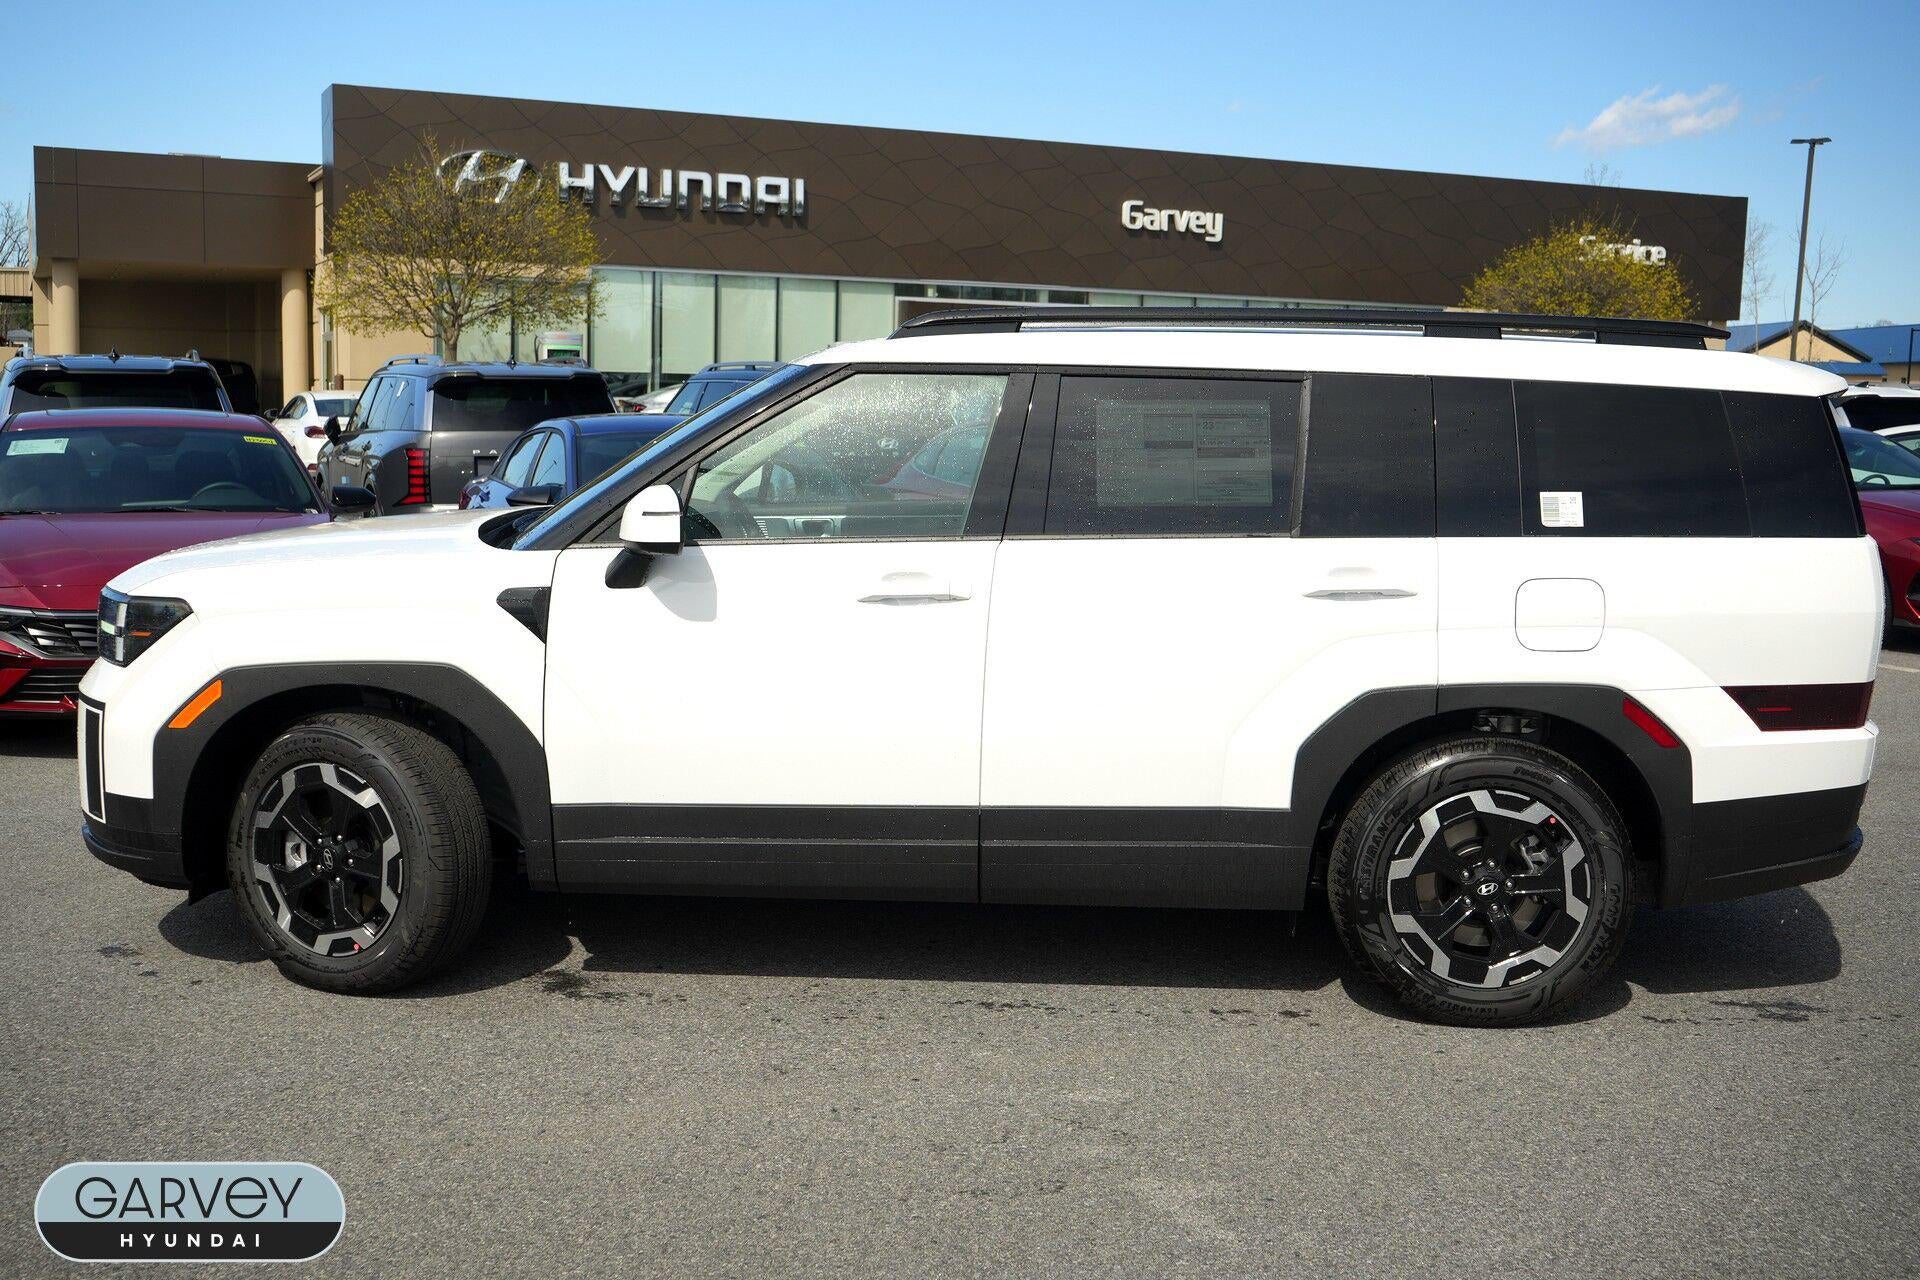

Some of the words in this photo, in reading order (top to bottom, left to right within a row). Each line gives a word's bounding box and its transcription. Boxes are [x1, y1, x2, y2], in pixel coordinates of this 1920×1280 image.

[558, 161, 804, 217] HYUNDAI
[1121, 199, 1224, 242] Garvey
[1578, 235, 1667, 266] Srvice
